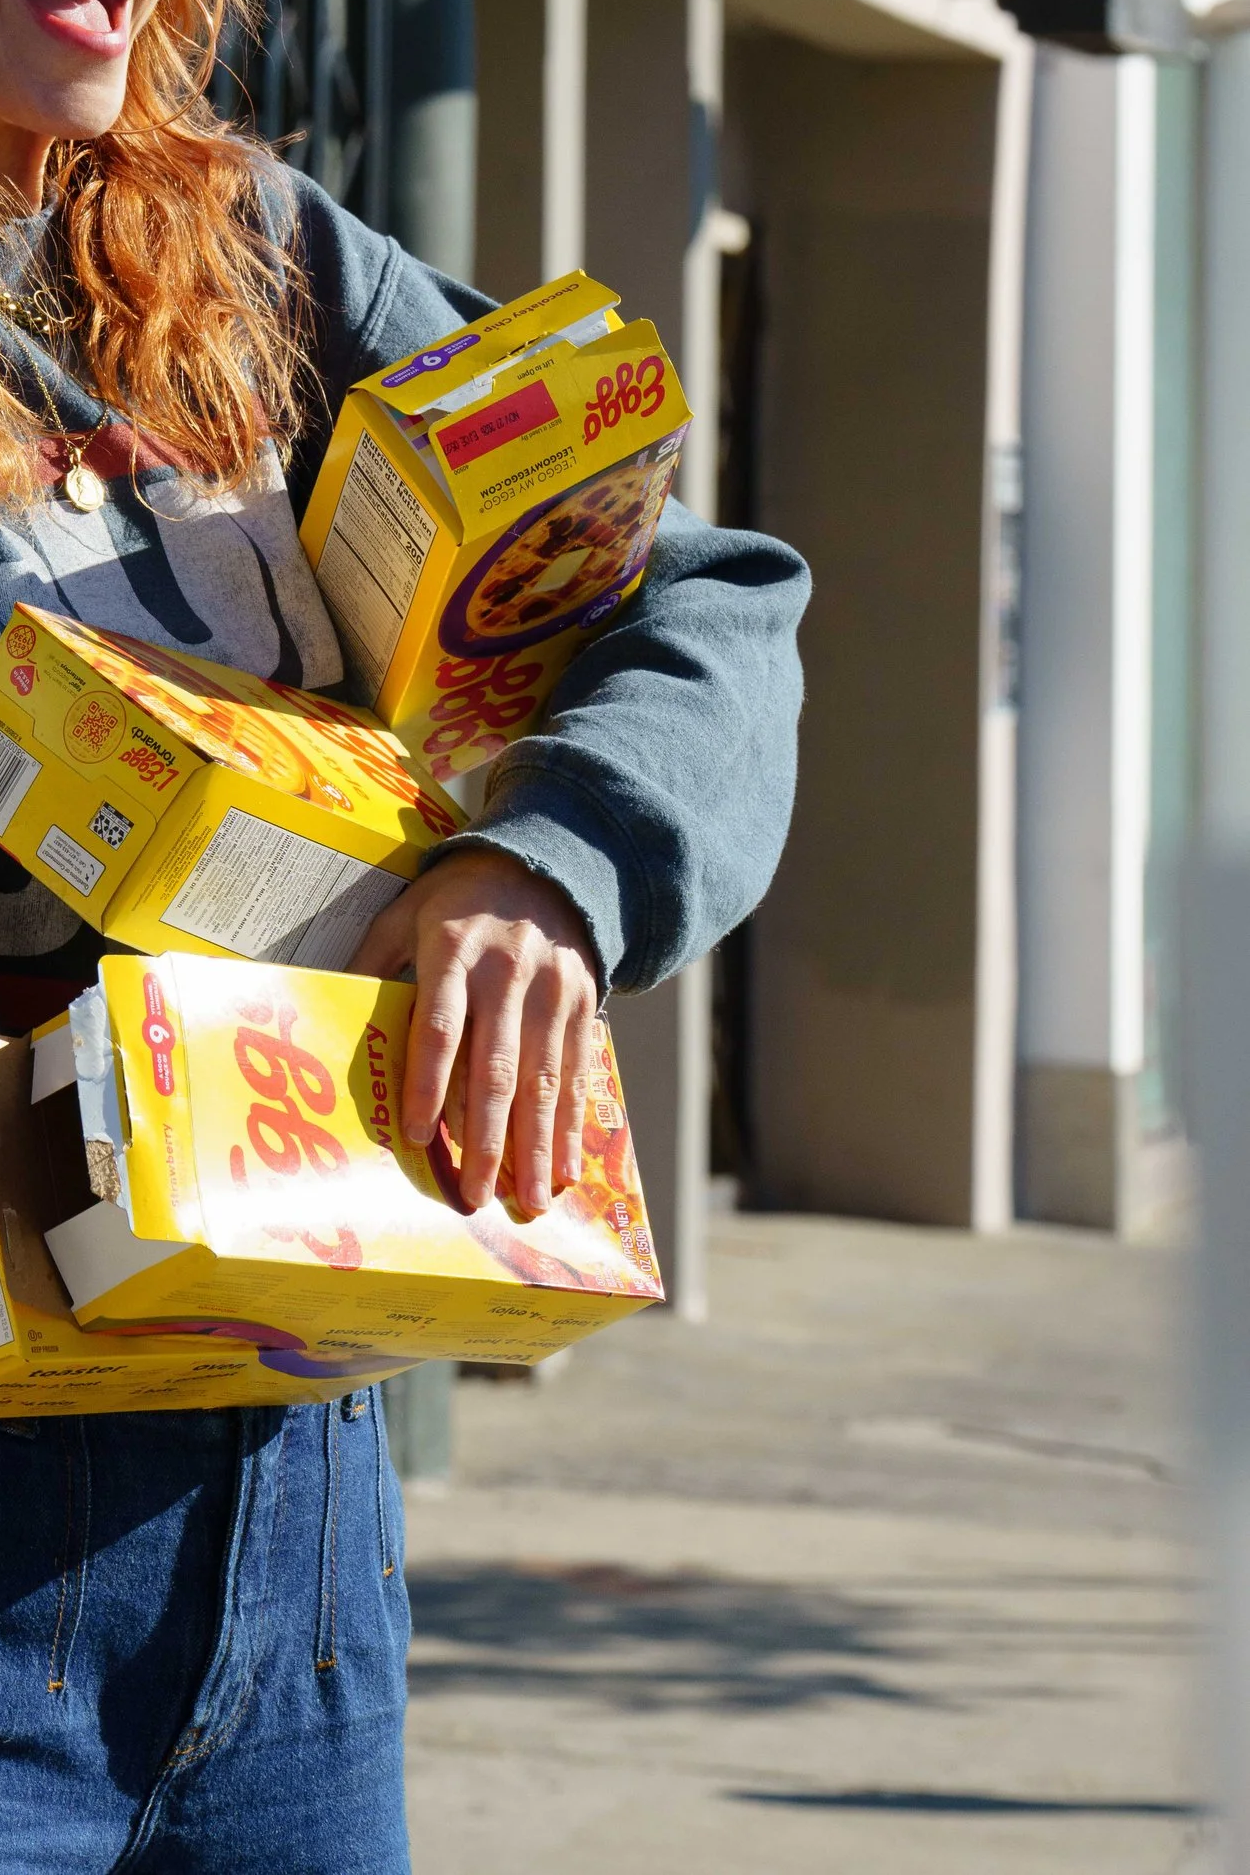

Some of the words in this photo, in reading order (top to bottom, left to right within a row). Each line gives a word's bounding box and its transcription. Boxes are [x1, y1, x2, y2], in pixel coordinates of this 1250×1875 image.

[511, 280, 580, 320] Chocolatey
[482, 314, 513, 335] Chip
[447, 343, 463, 355] GOOD
[422, 355, 440, 366] 9
[533, 364, 541, 372] to
[540, 357, 554, 369] Lift
[394, 366, 419, 384] VITAMINS
[515, 366, 535, 381] Open
[583, 355, 667, 446] Eggo
[493, 417, 505, 430] 27
[503, 409, 520, 425] NOV
[547, 417, 562, 428] BEST
[519, 433, 528, 442] By
[527, 427, 542, 438] Used
[655, 437, 675, 461] 10
[363, 432, 397, 481] Nutrition
[399, 479, 421, 512] Facts
[479, 445, 574, 499] LEGGOMYEGGO.COM
[536, 455, 578, 483] L'EGGO
[361, 439, 384, 472] Datos
[384, 470, 395, 487] de
[395, 485, 432, 537] Nutrición
[516, 476, 536, 492] MY
[405, 540, 422, 566] 200
[590, 603, 609, 619] 9
[11, 637, 26, 652] est.
[12, 630, 32, 645] 1936
[15, 666, 32, 684] U.S.A.
[58, 661, 87, 686] #BetterDays
[16, 674, 30, 691] Baked
[3, 739, 25, 759] 38000
[131, 726, 178, 767] forward
[236, 681, 371, 801] Homestyle
[118, 749, 179, 791] L'Eggo
[324, 784, 343, 800] 9
[101, 807, 116, 820] PLASTIC
[219, 812, 238, 840] CONTIENE
[207, 831, 222, 851] HUEVO
[45, 842, 75, 868] leggomyeggo.com
[264, 834, 291, 874] INGREDIENTS.
[275, 836, 294, 864] CONTAINS
[41, 848, 65, 870] Comments?
[78, 859, 86, 868] Call:
[194, 840, 221, 881] INGREDIENTES
[72, 864, 82, 875] Visit:
[68, 870, 89, 890] Questions
[189, 882, 196, 890] DE
[175, 890, 190, 909] TRIGO,
[244, 904, 254, 916] EGG
[237, 917, 247, 929] AND
[229, 930, 239, 942] SOY
[147, 984, 155, 1015] VITAMINS
[148, 1023, 170, 1044] 9
[162, 1053, 168, 1061] OF
[162, 1062, 170, 1089] SOURCE
[597, 1103, 611, 1124] 180
[609, 1103, 618, 1126] CALORIES
[615, 1201, 629, 1227] NETO
[634, 1225, 650, 1256] (350g)
[640, 1258, 651, 1271] OZ
[385, 1311, 422, 1323] bake
[485, 1304, 528, 1316] enjoy
[549, 1314, 587, 1326] laugh
[325, 1325, 389, 1337] preheat
[31, 1345, 42, 1353] KEEP
[42, 1344, 58, 1353] FROZEN
[316, 1338, 373, 1350] oven
[462, 1335, 500, 1347] heat
[27, 1364, 128, 1378] toaster
[193, 1362, 248, 1371] oven
